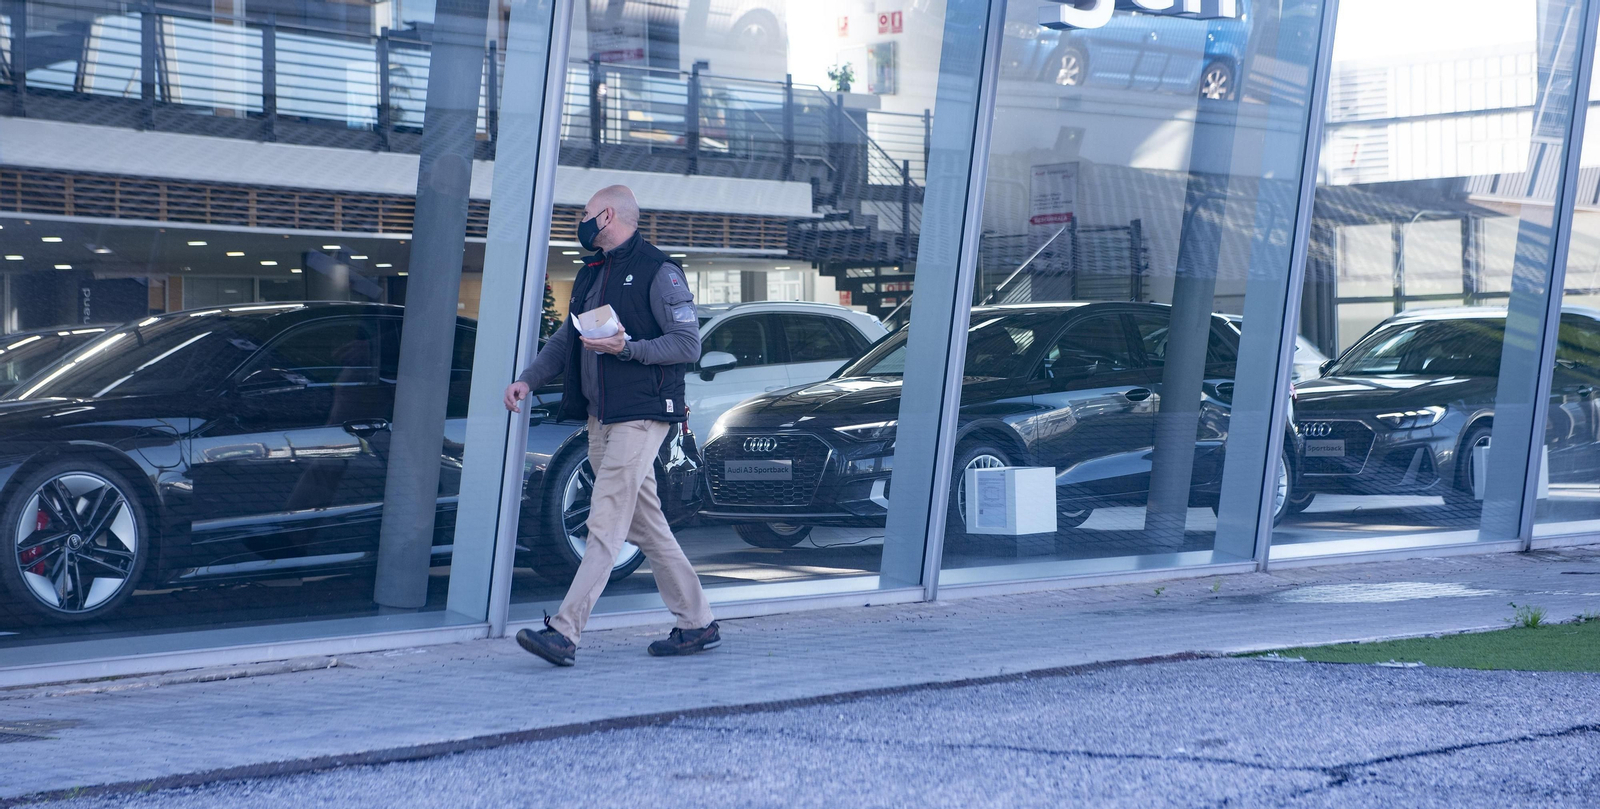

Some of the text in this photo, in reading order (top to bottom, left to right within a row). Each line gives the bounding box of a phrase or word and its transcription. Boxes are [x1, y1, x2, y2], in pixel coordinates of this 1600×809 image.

[727, 466, 789, 474] Audi A3 Sportback
